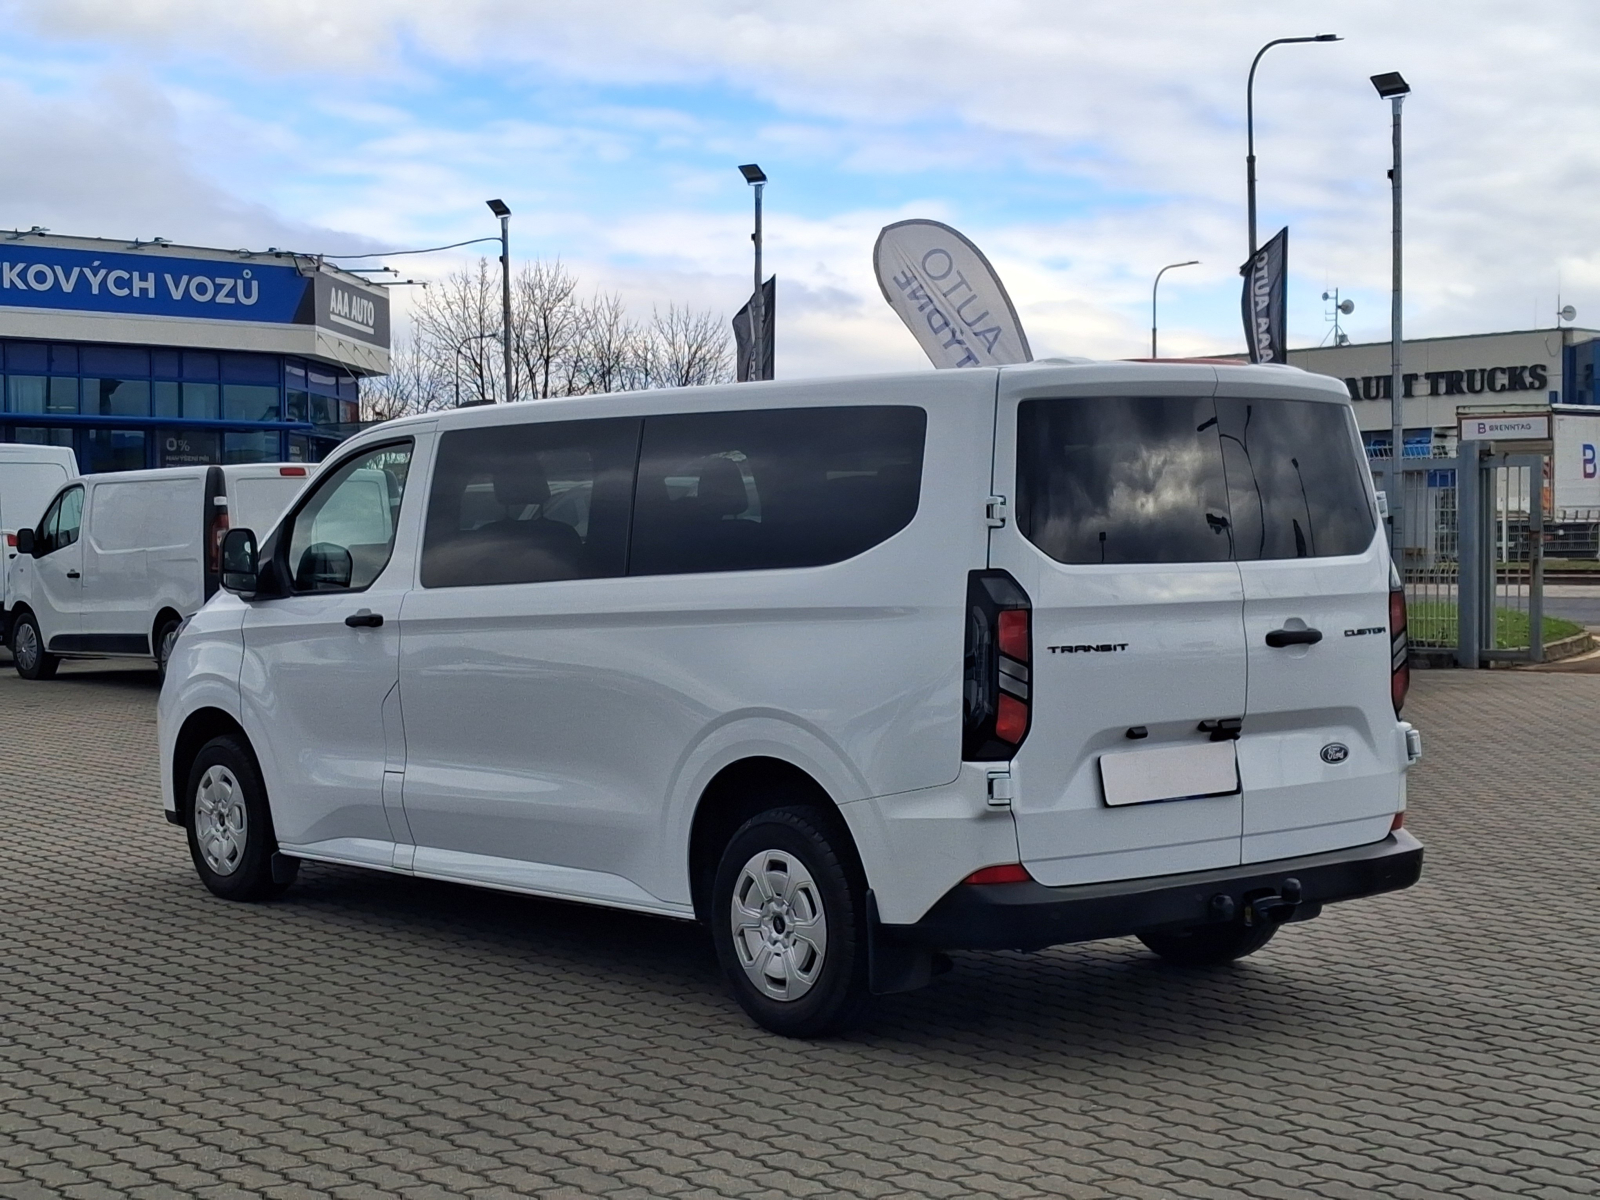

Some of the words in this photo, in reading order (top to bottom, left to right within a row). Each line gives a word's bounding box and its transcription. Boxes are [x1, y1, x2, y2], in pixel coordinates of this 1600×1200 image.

[0, 261, 155, 298] KOVÝCH
[164, 269, 259, 305] VOZŮ
[330, 286, 350, 318] AAA
[351, 295, 375, 327] AUTO
[1340, 373, 1418, 401] AULT
[1424, 364, 1548, 396] TRUCKS
[1489, 423, 1532, 432] BRENNTAG
[166, 437, 191, 452] 0%
[1047, 643, 1129, 654] TRANSIT
